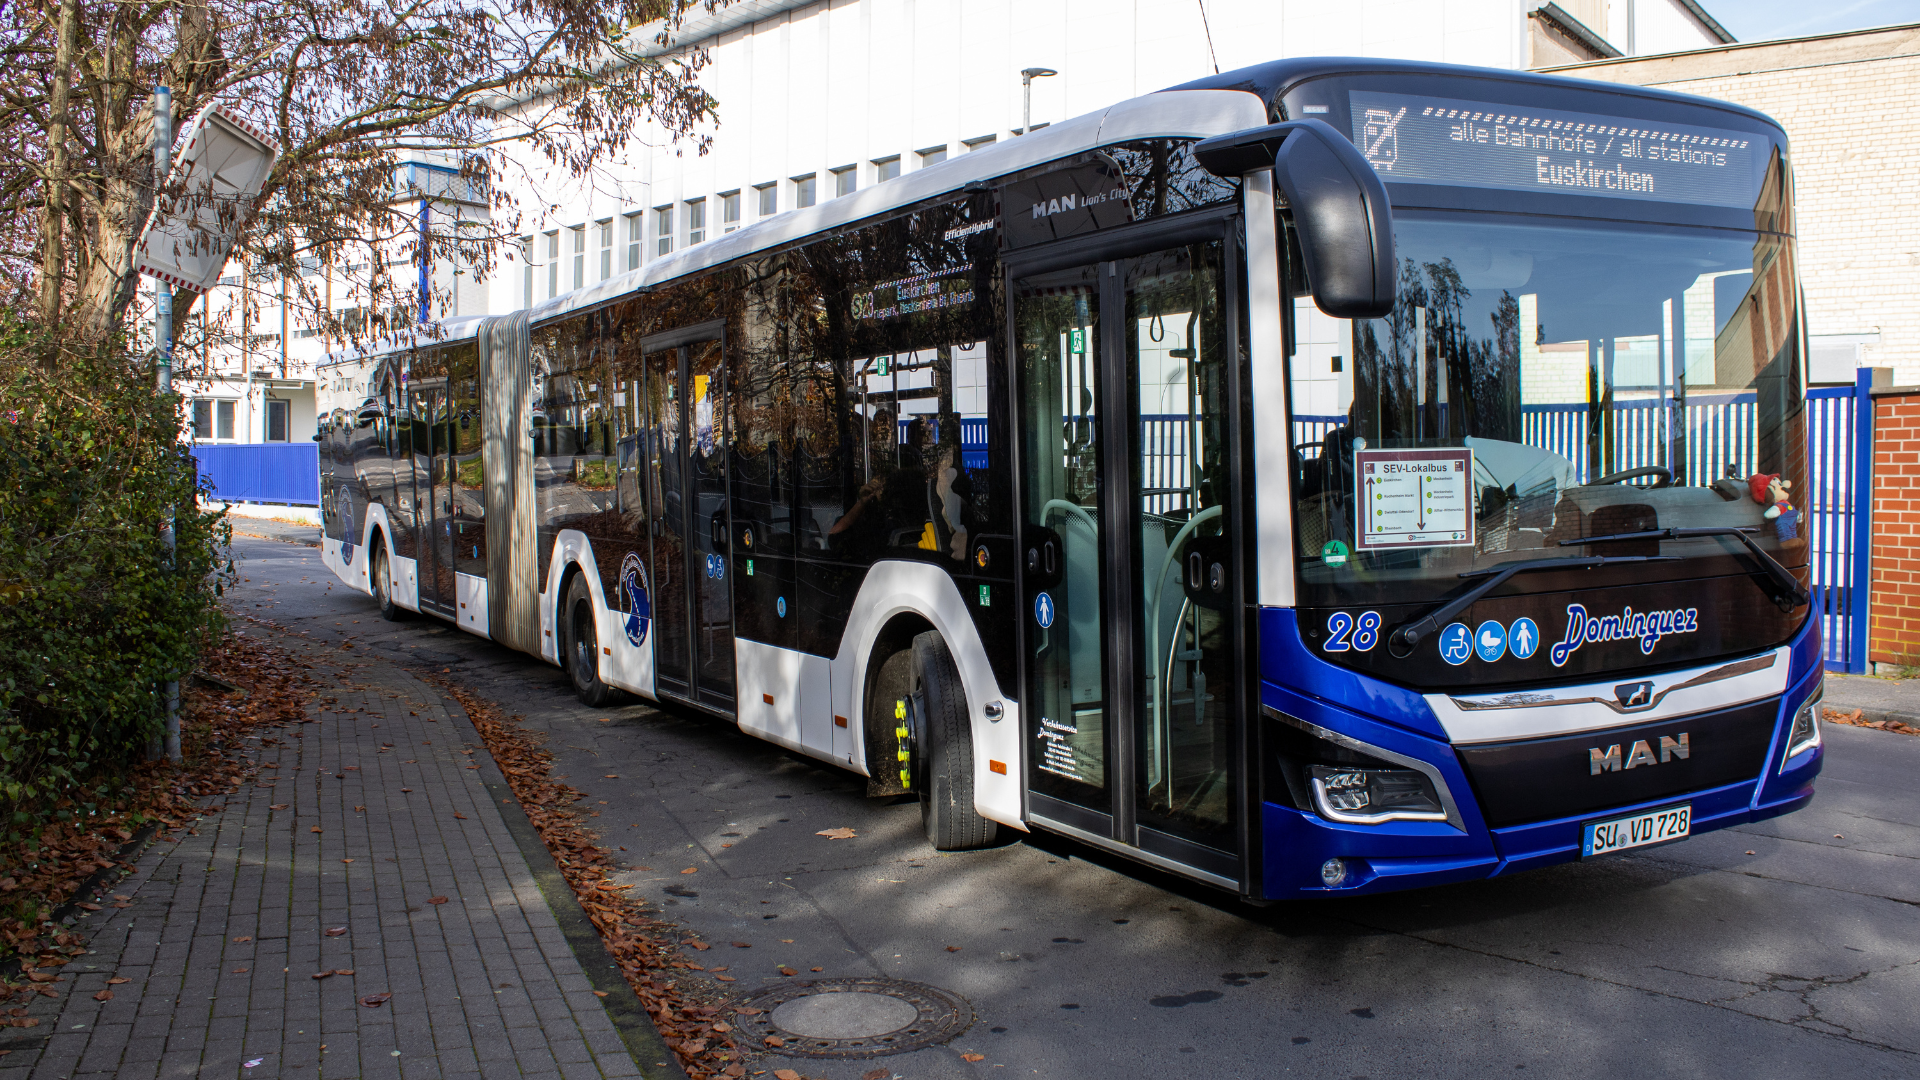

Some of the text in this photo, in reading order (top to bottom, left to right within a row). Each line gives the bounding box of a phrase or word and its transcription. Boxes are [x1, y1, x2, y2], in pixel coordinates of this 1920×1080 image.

[1450, 122, 1488, 143] alle
[1495, 125, 1597, 154] Bahnhöfe
[1621, 140, 1643, 158] all
[1648, 143, 1727, 167] stations
[1536, 155, 1654, 193] Euskirchen
[1032, 188, 1130, 219] MAN Lion's City
[944, 219, 994, 241] EfficientHybrid
[897, 279, 940, 301] Euskirchen
[1383, 463, 1448, 474] SEV-Lokalbus
[1331, 542, 1340, 555] 4
[1323, 610, 1382, 653] 28
[1551, 603, 1698, 668] Dominguez
[1588, 732, 1690, 776] MAN
[1594, 810, 1688, 851] SU VD 728
[1585, 844, 1591, 852] D
